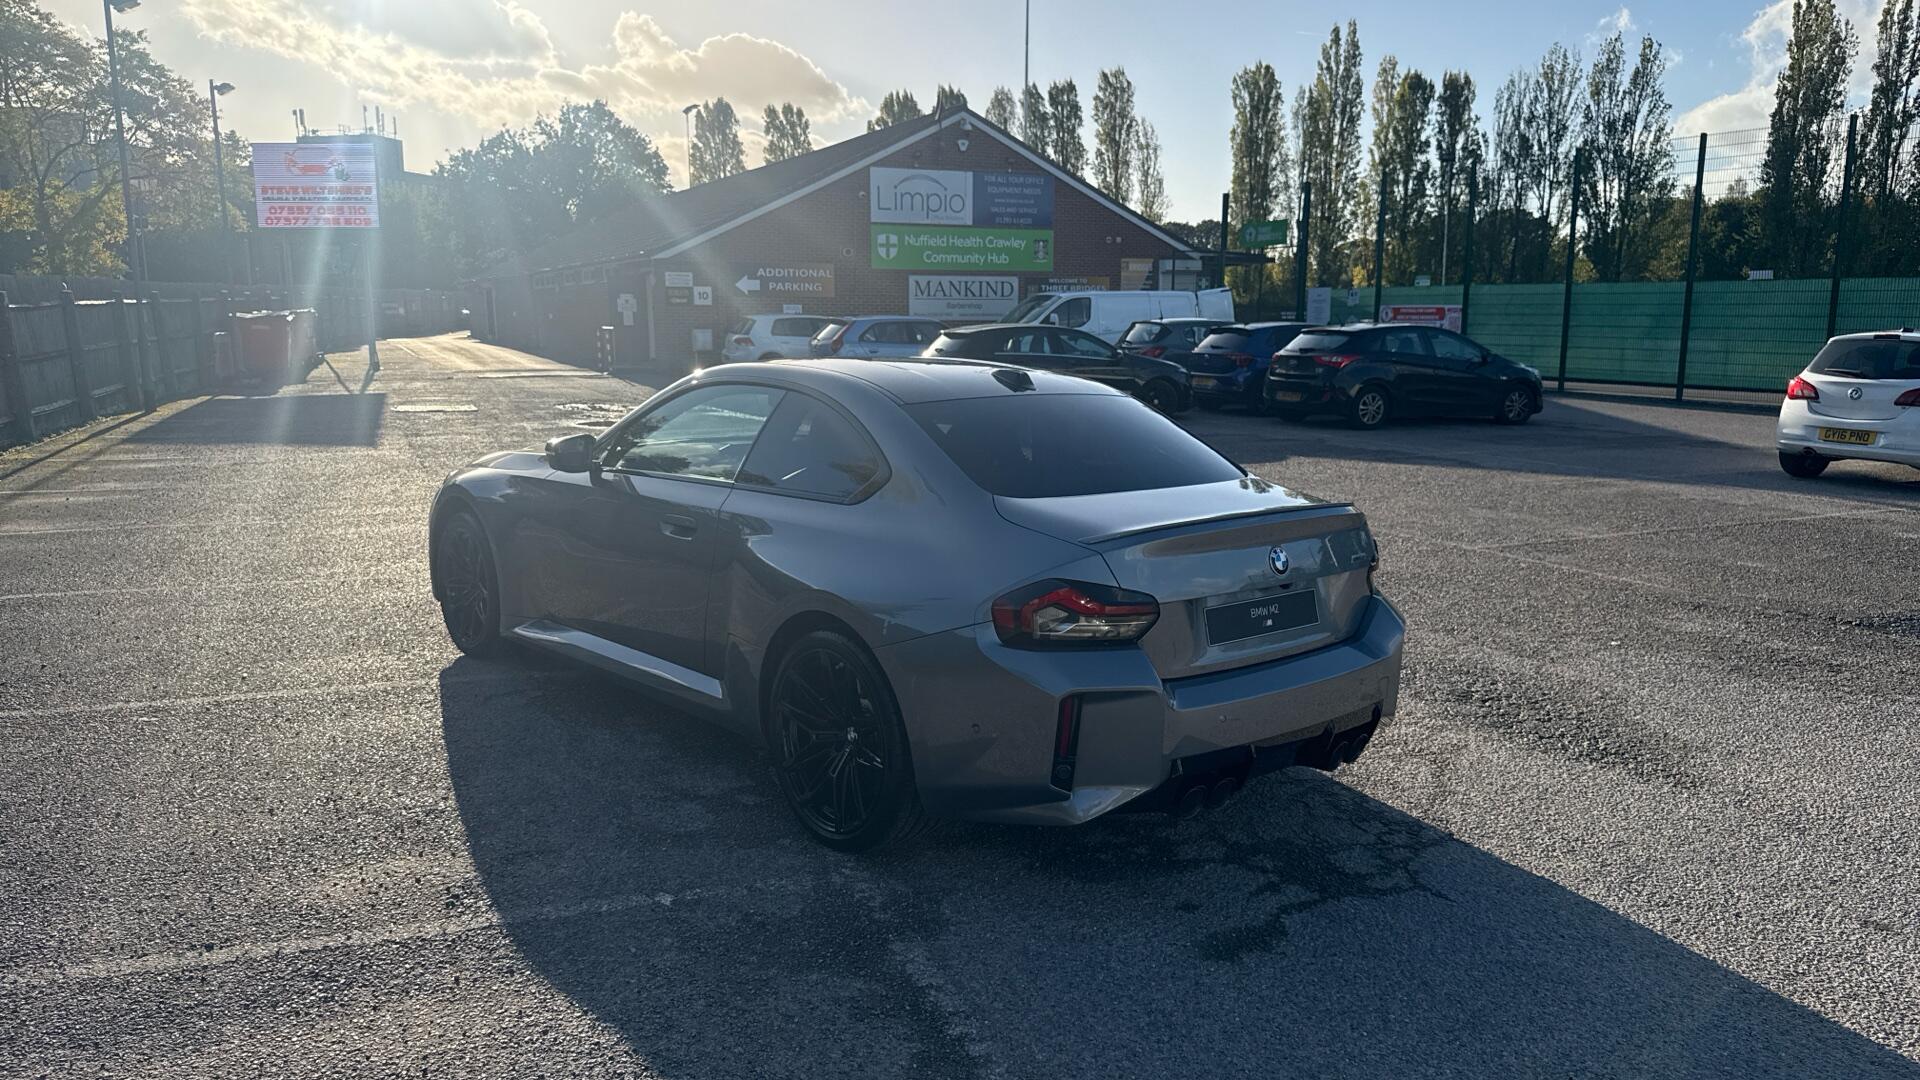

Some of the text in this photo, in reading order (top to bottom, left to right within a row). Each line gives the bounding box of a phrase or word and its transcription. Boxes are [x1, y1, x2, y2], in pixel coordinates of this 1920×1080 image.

[877, 185, 965, 219] Limpio
[904, 234, 1026, 250] Nuffield Health Crawley
[923, 251, 1009, 265] Community Hub
[757, 268, 833, 278] ADDITIONAL
[769, 282, 823, 291] PARKING
[914, 280, 1014, 297] MANKIND
[1041, 284, 1068, 292] THREE
[1824, 429, 1847, 439] GY16
[1250, 603, 1280, 618] BMW M2
